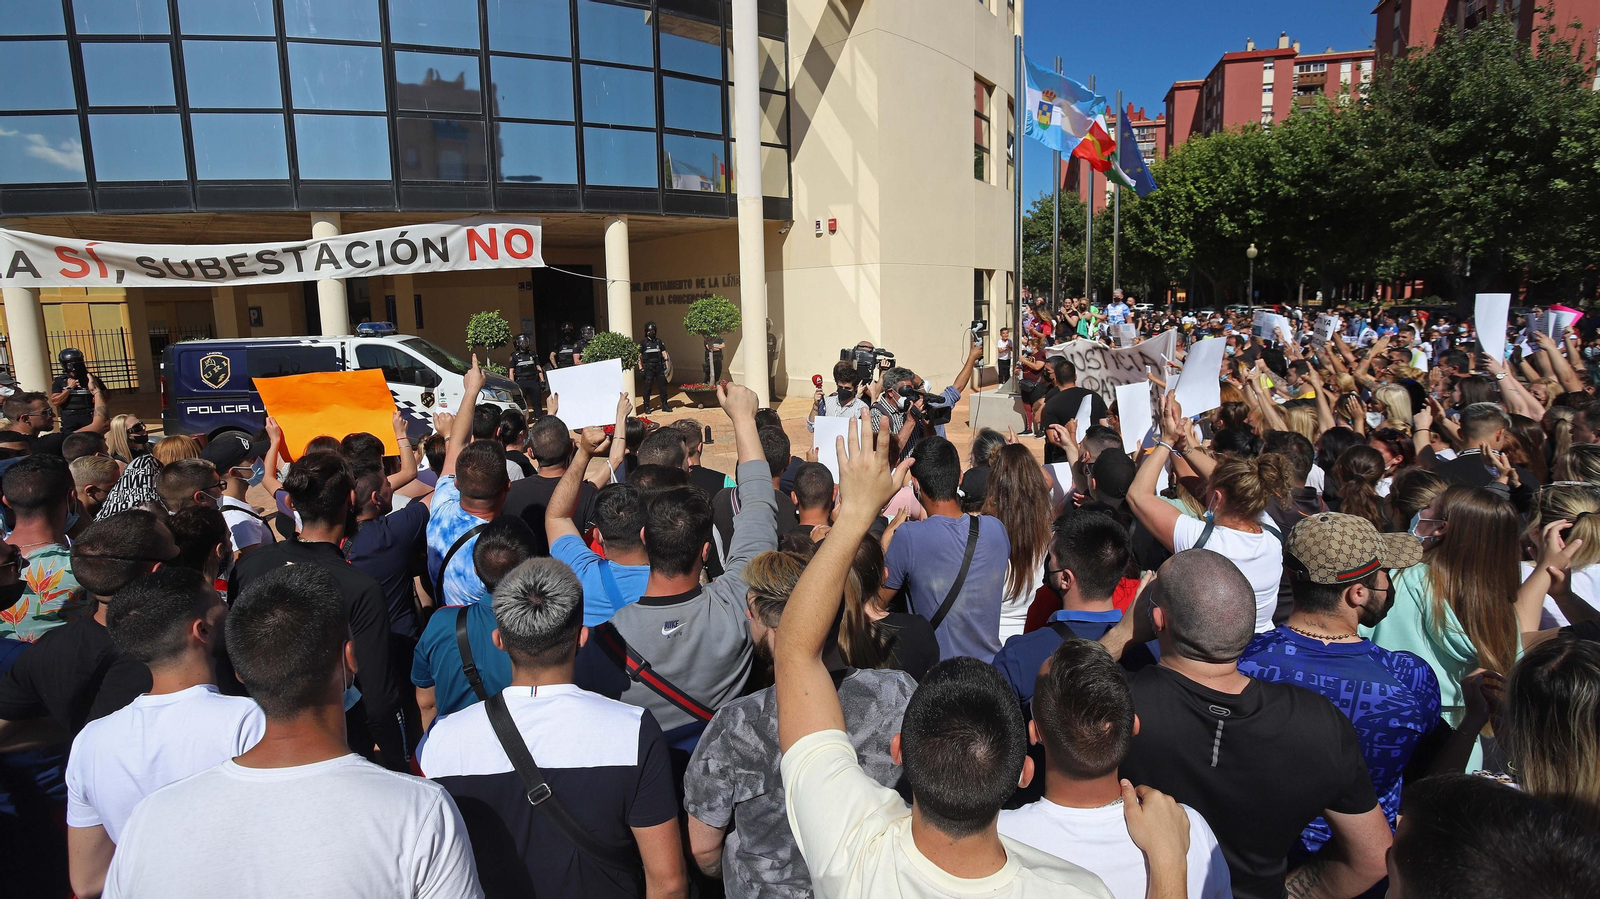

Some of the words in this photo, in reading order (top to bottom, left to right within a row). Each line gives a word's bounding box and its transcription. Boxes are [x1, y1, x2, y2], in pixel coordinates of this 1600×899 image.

[0, 250, 42, 278] A
[136, 231, 449, 279] SUBESTACIÓN
[466, 228, 534, 261] NO
[643, 279, 692, 292] AYUNTAMIENTO
[696, 278, 706, 288] DE
[709, 277, 719, 288] LA
[645, 295, 654, 305] DE
[656, 295, 665, 305] LA
[203, 361, 227, 379] URI
[187, 405, 250, 414] POLICIA
[253, 405, 267, 413] L
[664, 620, 680, 629] NIKE
